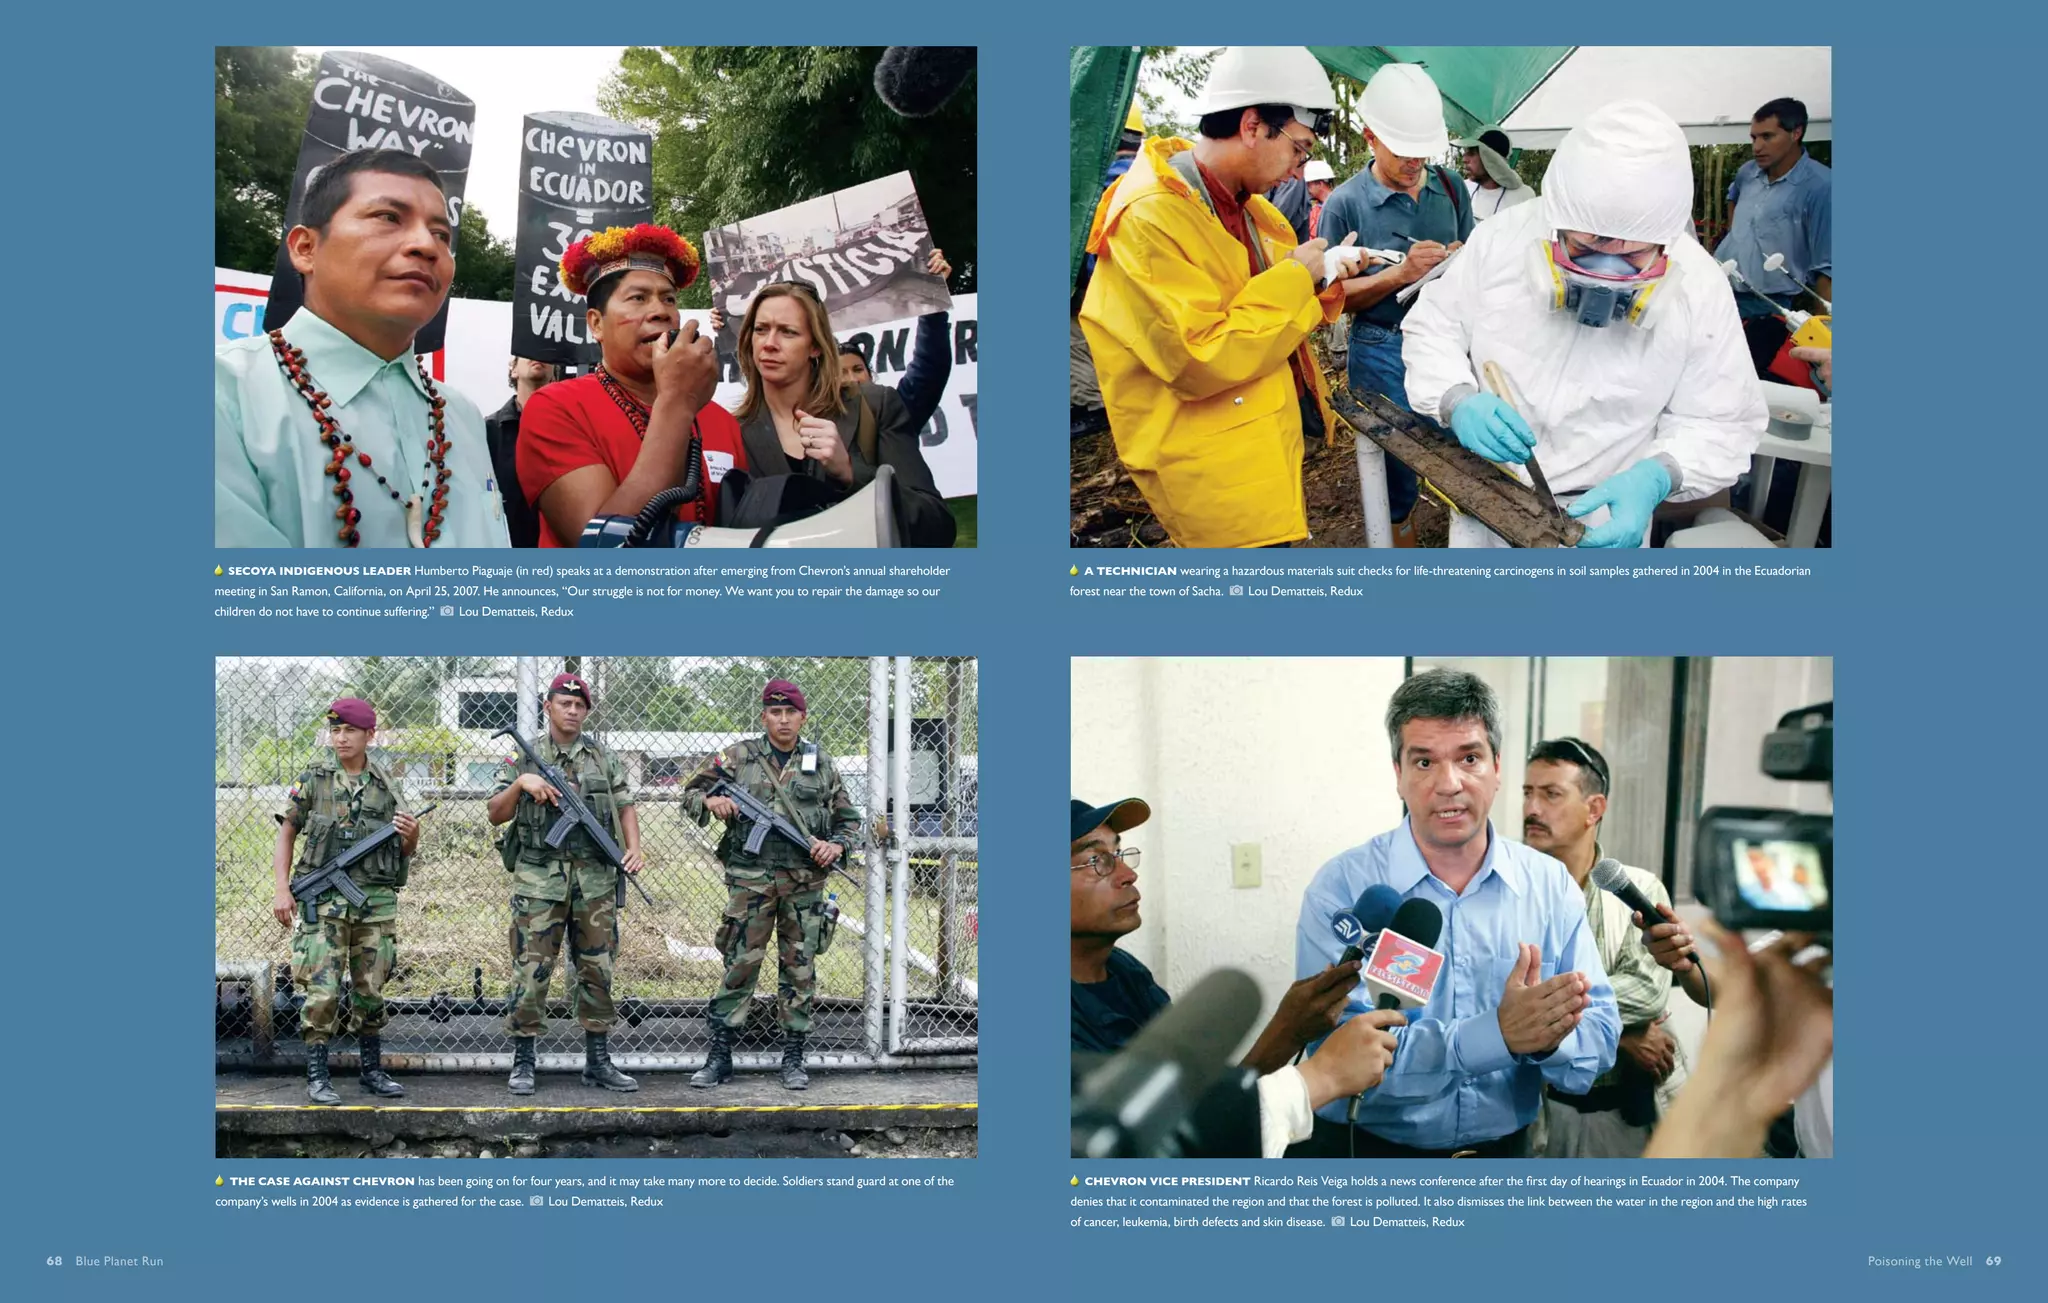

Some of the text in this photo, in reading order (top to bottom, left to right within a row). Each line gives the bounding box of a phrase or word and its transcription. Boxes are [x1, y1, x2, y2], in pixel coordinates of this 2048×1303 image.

[314, 77, 475, 145] CHEVRON
[530, 166, 645, 204] ECUADOR
[579, 162, 597, 176] IN
